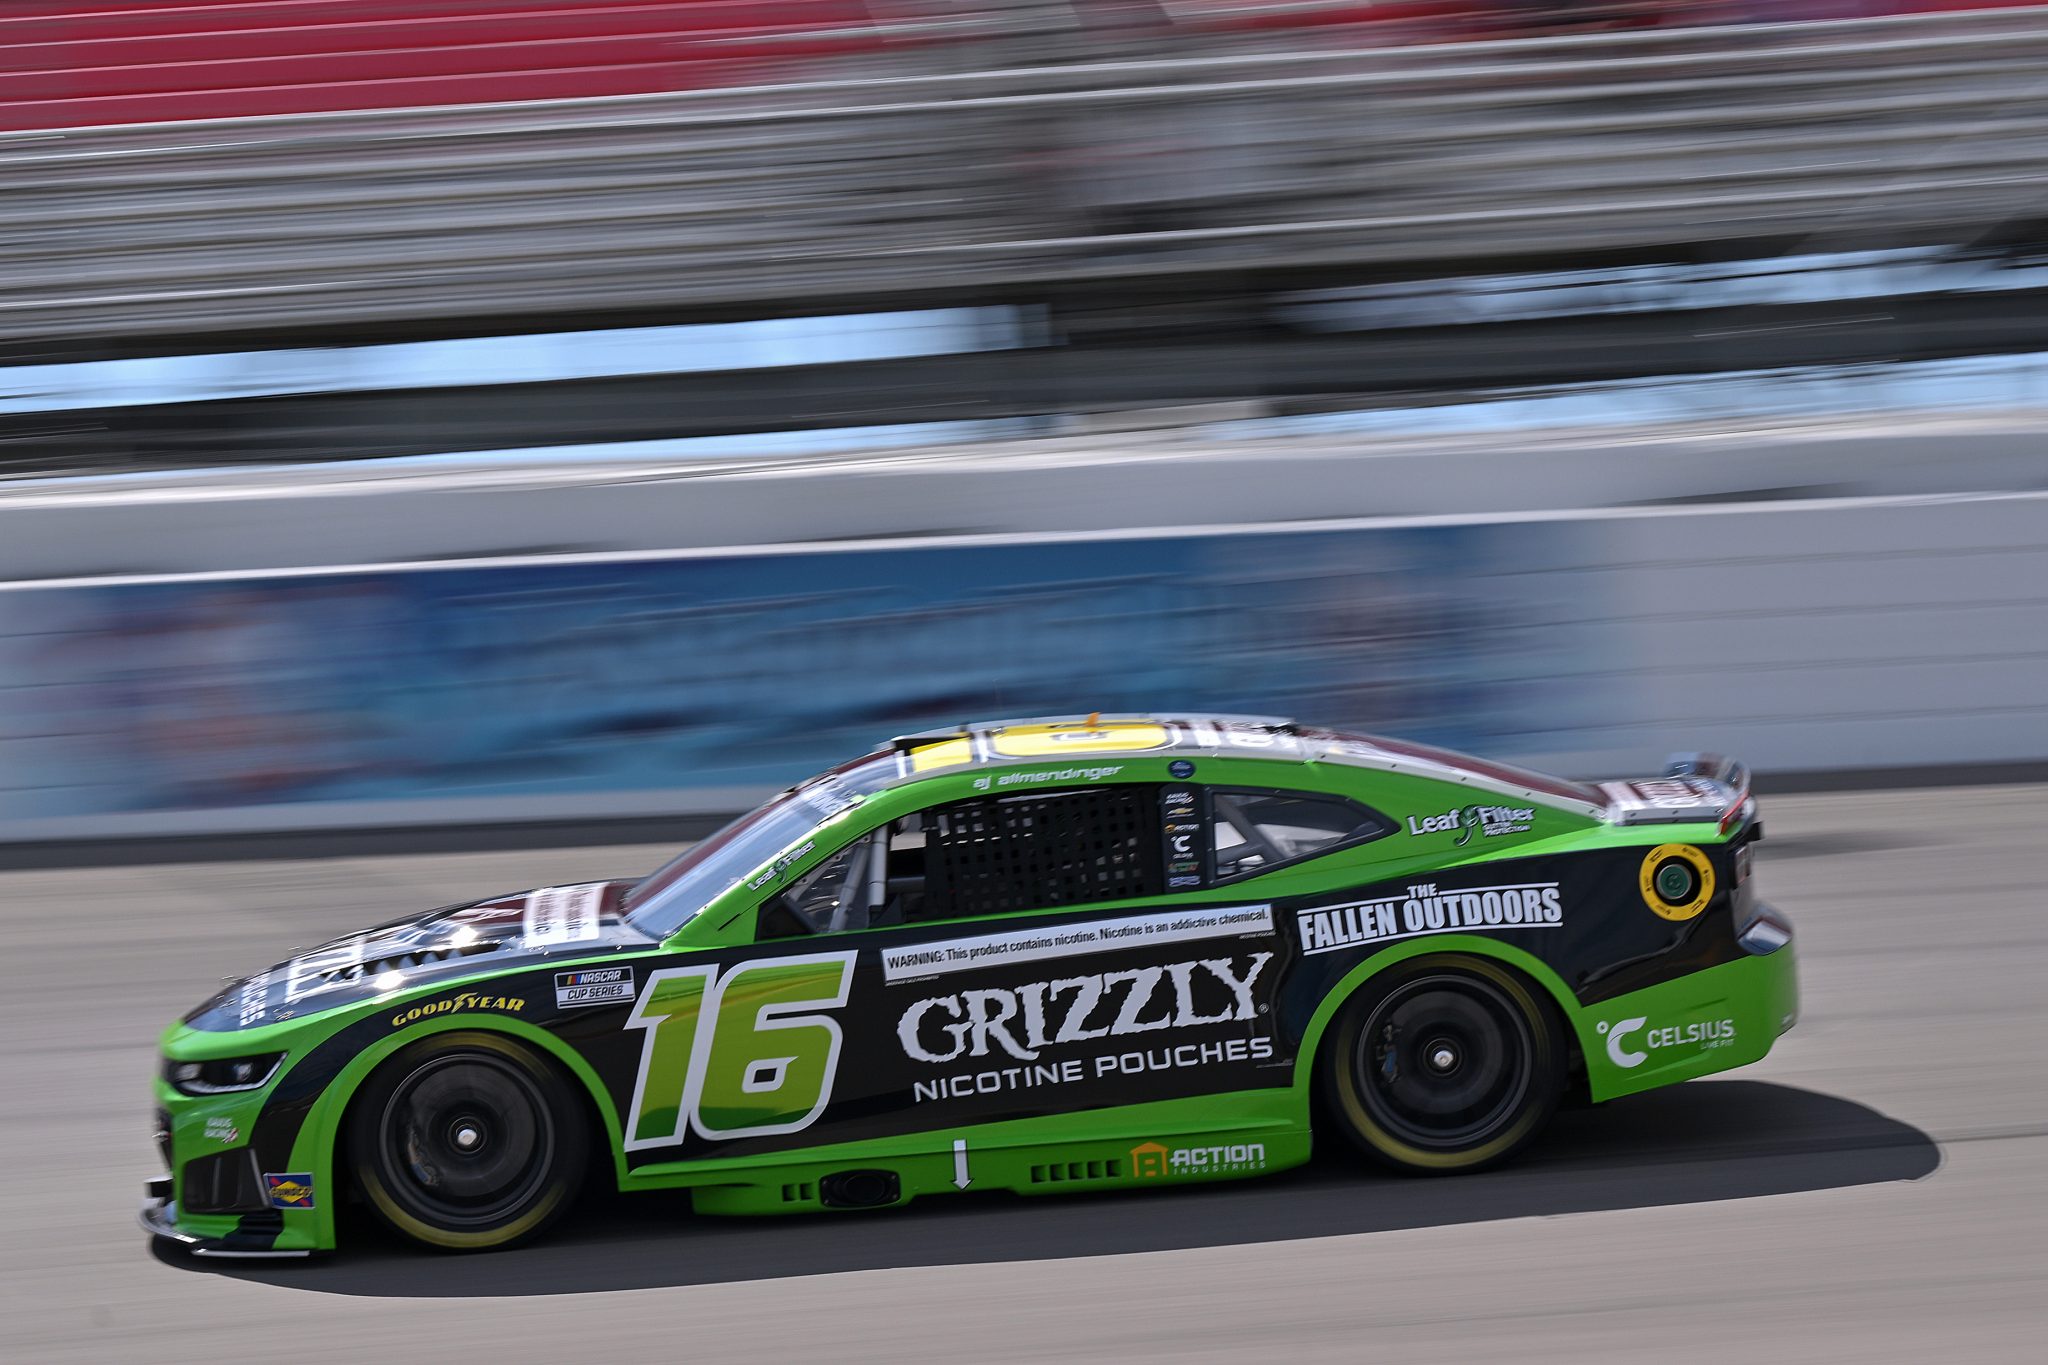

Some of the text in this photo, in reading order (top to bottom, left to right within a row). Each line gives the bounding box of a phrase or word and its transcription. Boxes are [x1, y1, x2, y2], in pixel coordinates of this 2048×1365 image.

[972, 765, 1124, 790] aj allmendinger
[1406, 805, 1536, 836] Leaf Filter
[747, 866, 777, 891] Leaf
[1407, 883, 1438, 899] THE
[1297, 888, 1563, 951] FALLEN OUTDOORS
[887, 908, 1269, 970] WARNING: This product contains nicotine. Nicotine is an addictive chemical.
[567, 984, 624, 1000] CUP SERIES
[578, 970, 622, 984] NASCAR
[391, 992, 526, 1027] GOODYEAR
[896, 951, 1274, 1065] GRIZZLY
[1647, 1019, 1735, 1049] CELSIUS
[623, 949, 859, 1153] 16
[914, 1036, 1273, 1103] NICOTINE POUCHES
[1169, 1143, 1265, 1168] ACTION
[1172, 1161, 1266, 1176] INDUSTRIES
